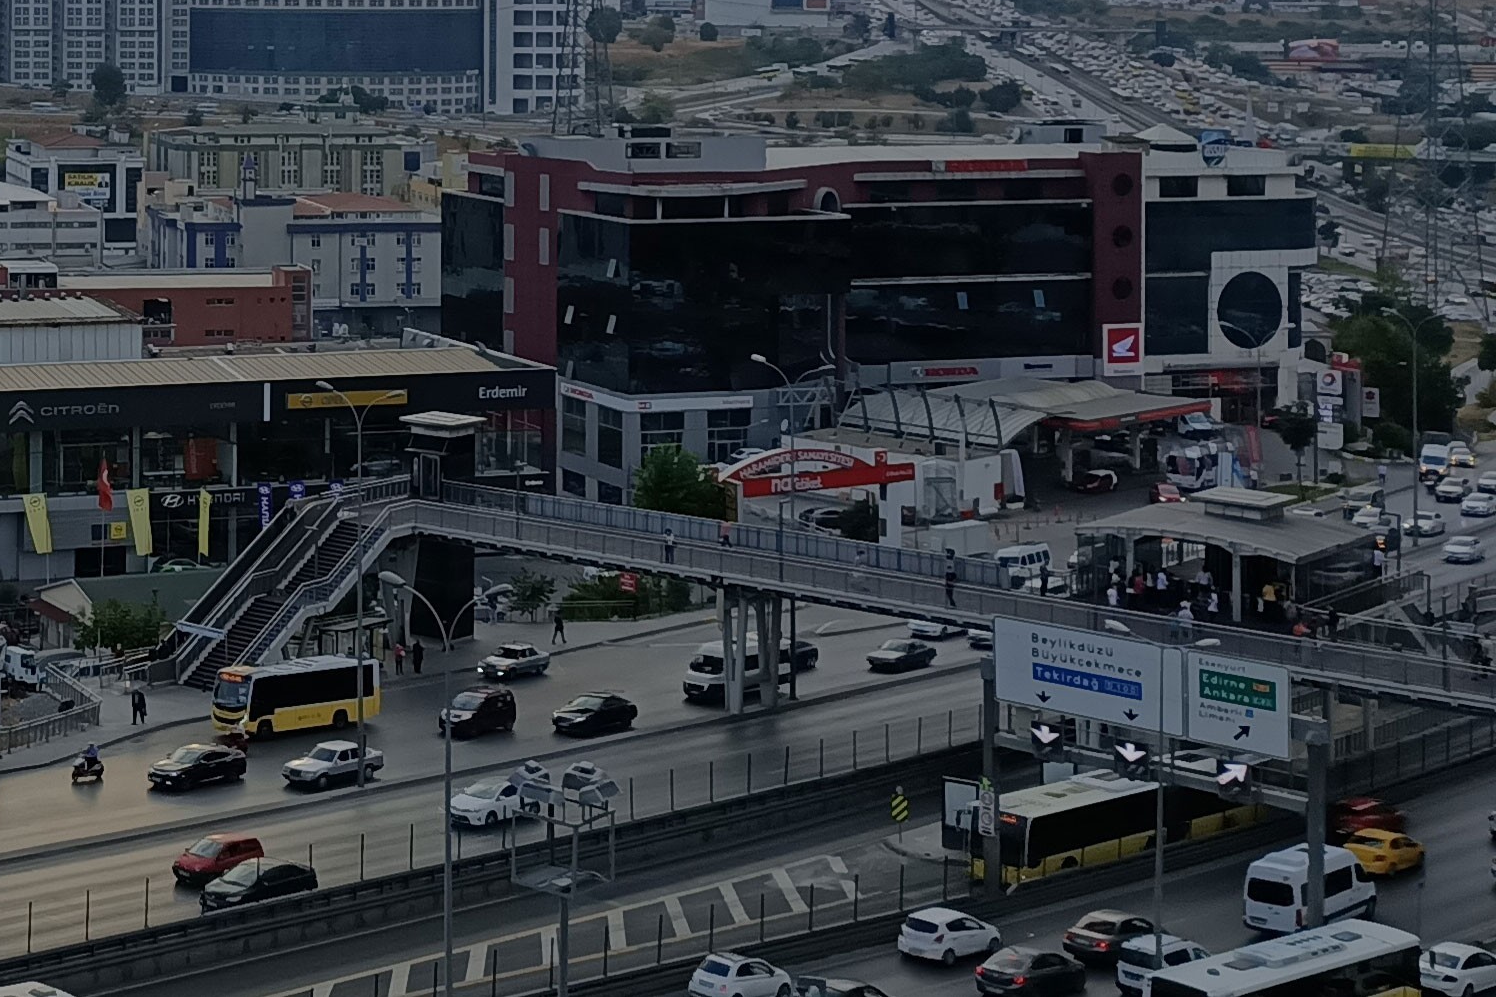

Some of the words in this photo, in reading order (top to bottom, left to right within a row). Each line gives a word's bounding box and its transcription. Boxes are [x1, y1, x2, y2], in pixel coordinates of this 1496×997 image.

[478, 384, 528, 399] Erdemir
[1031, 632, 1114, 658] Beylikdüzü
[1031, 647, 1143, 678] Büyükçekmece
[1199, 658, 1246, 673] Esenyurt
[1035, 667, 1099, 691] Tekirdağ
[1202, 673, 1246, 690] Edirne
[1203, 686, 1250, 704] Ankara
